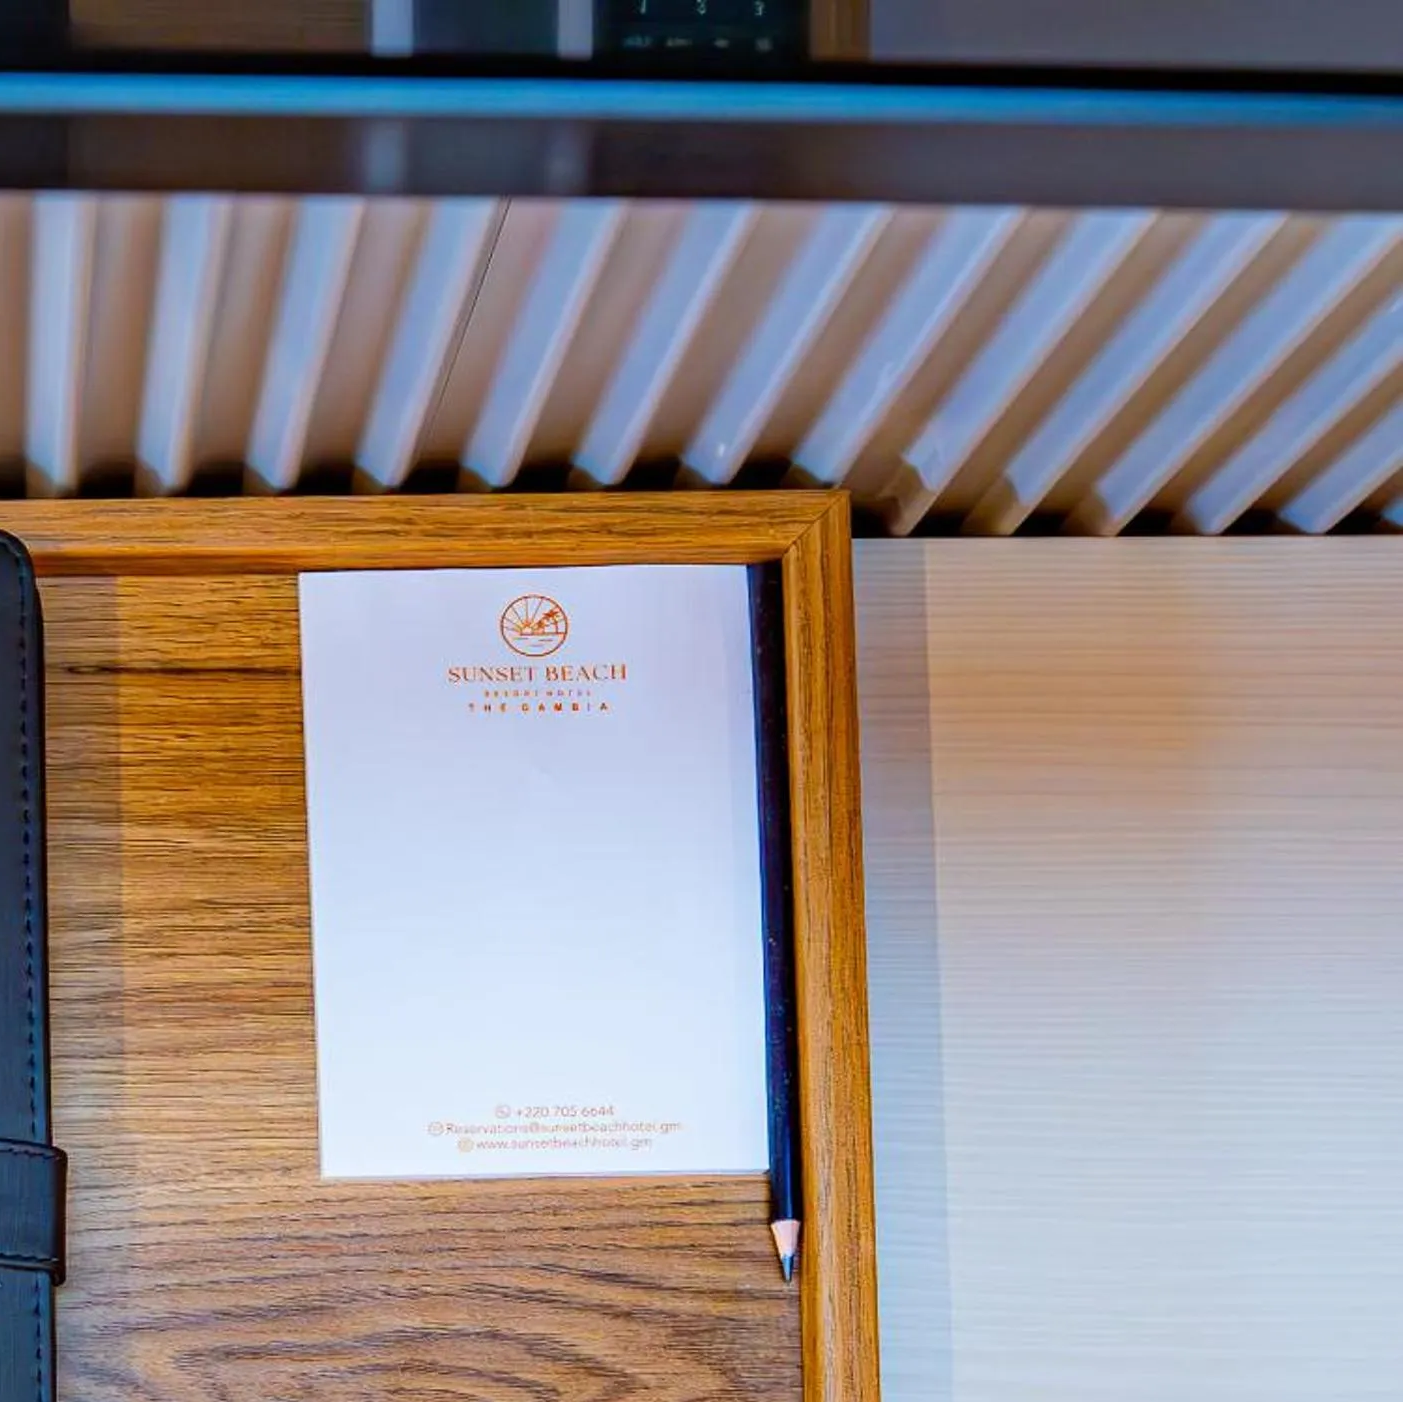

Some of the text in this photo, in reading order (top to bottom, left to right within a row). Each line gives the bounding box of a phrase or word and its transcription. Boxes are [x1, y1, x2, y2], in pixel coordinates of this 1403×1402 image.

[448, 663, 628, 683] SUNSET BEACH
[468, 702, 608, 712] THE GAMBIA
[555, 1105, 578, 1117] 705
